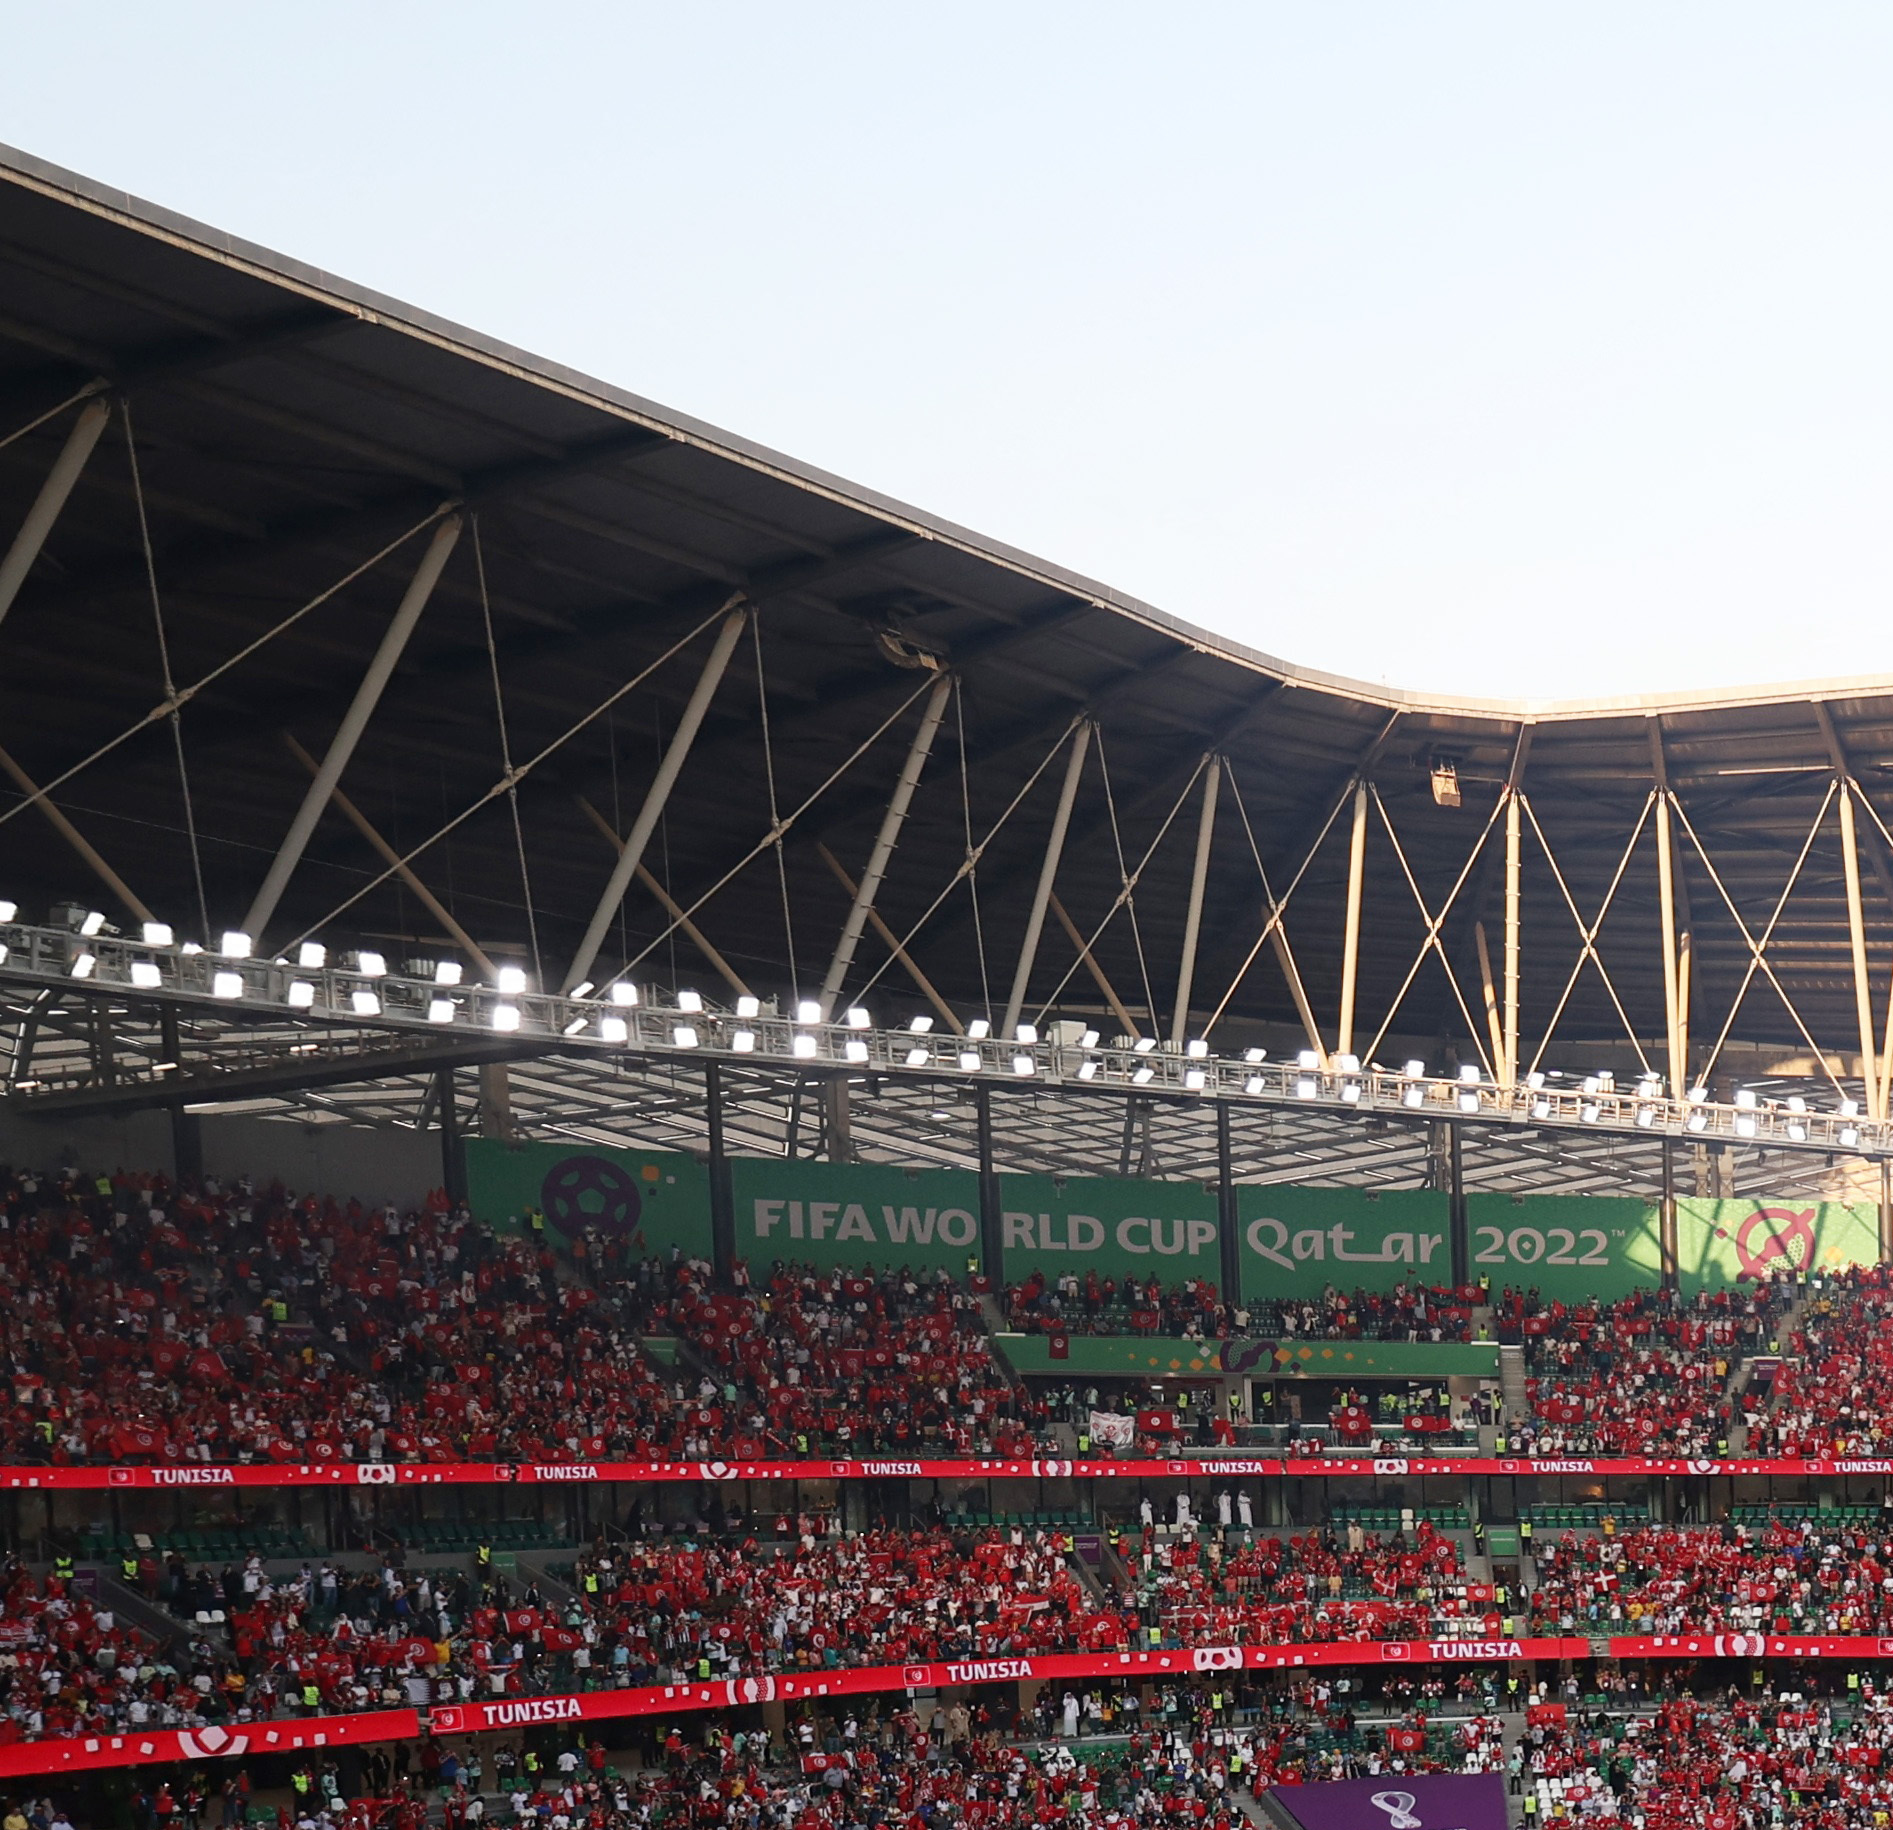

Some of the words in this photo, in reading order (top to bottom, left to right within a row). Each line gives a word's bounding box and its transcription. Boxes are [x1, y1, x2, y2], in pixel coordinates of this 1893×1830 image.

[755, 1199, 877, 1241] FIFA
[882, 1206, 1104, 1250] WORLD
[1117, 1218, 1216, 1254] CUP
[1247, 1218, 1442, 1270] Qatar
[534, 1466, 597, 1479] TUNISIA
[862, 1463, 921, 1474] TUNISIA
[1200, 1462, 1263, 1473] TUNISIA
[1531, 1462, 1593, 1472] TUNISIA
[1833, 1462, 1891, 1472] TUNISIA
[152, 1469, 233, 1483] TUNISIA
[1429, 1642, 1522, 1658] TUNISIA
[947, 1661, 1031, 1681] TUNISIA
[483, 1699, 581, 1724] TUNISIA
